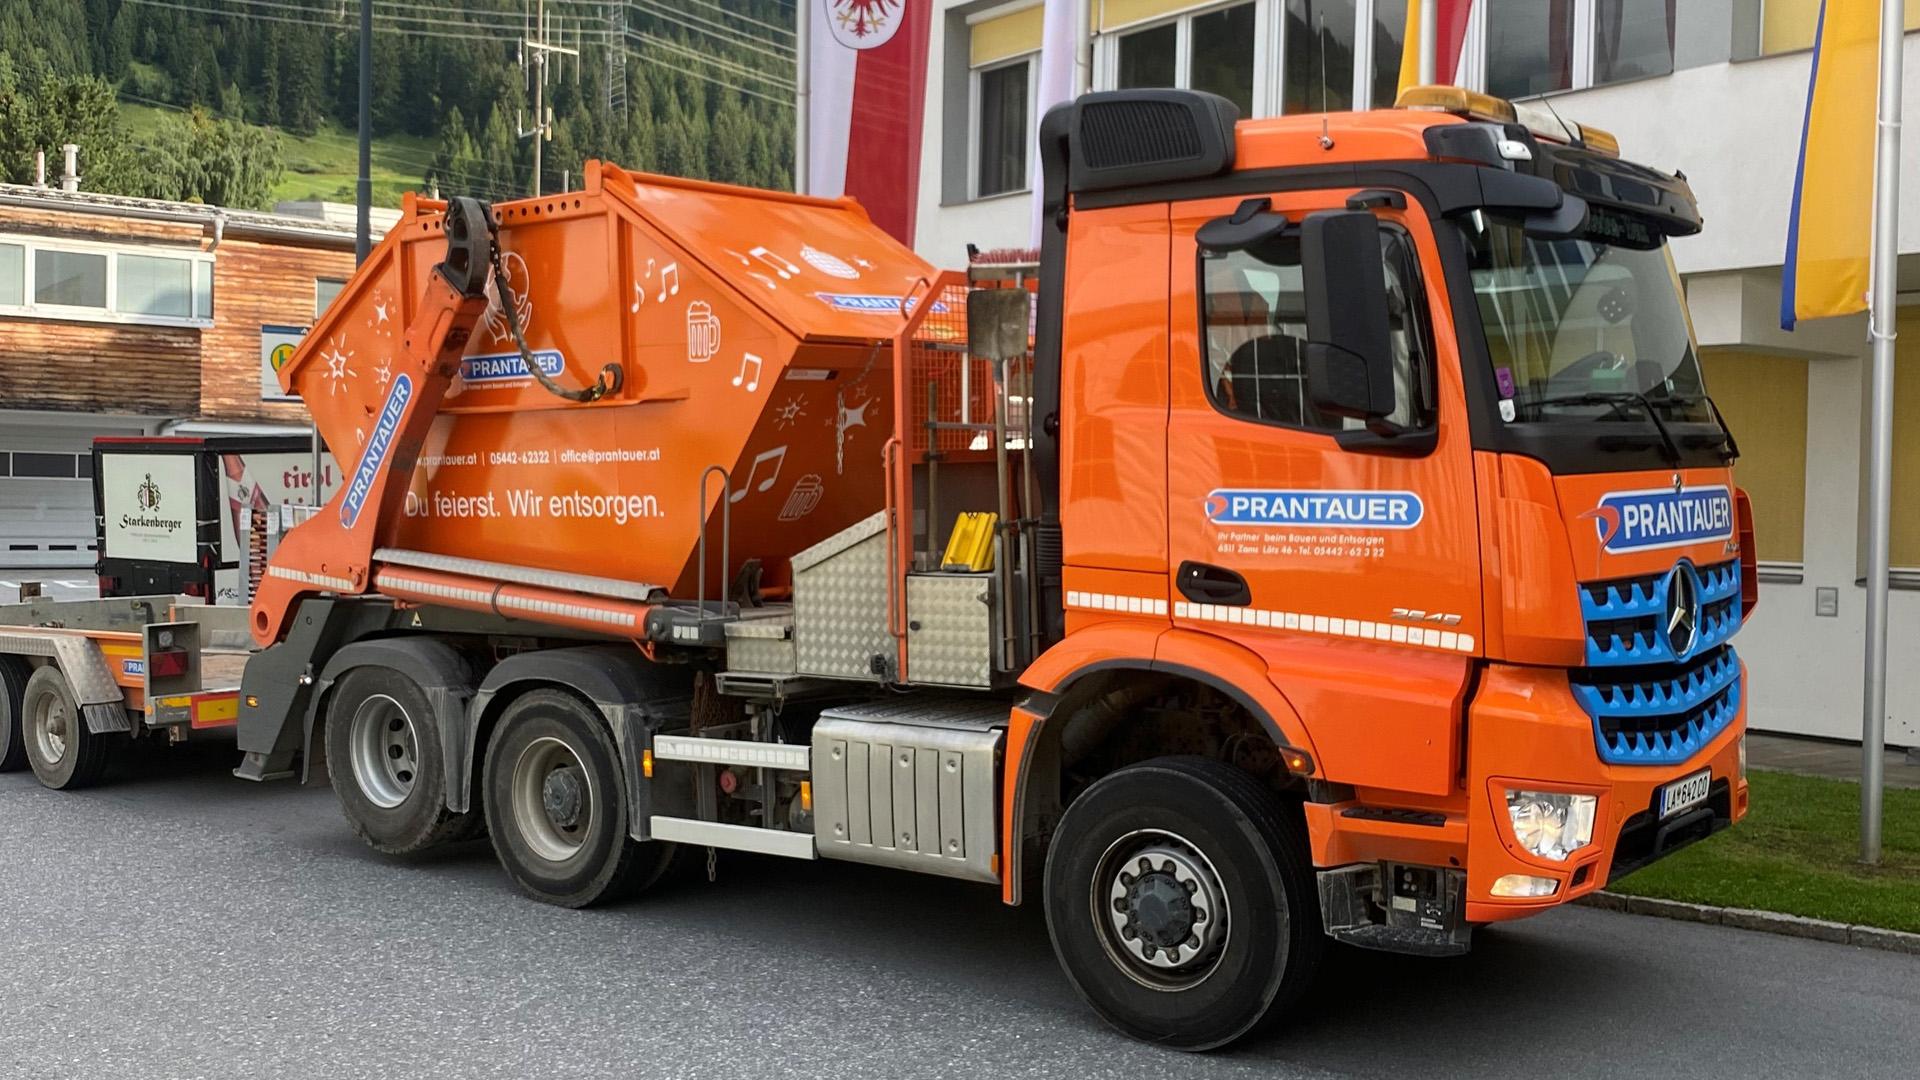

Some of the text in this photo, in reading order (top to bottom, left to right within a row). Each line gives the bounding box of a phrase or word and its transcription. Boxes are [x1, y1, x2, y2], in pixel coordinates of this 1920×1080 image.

[349, 383, 408, 510] PRANTAUER
[490, 452, 550, 465] 05442-62322
[561, 448, 660, 465] office@prantauer.at
[405, 489, 665, 525] Du feierst. Wir entsorgen.
[1232, 496, 1408, 521] PRANTAUER
[119, 514, 182, 532] Starkenberger
[1623, 497, 1730, 540] PRANTAUER
[1218, 532, 1384, 546] Ihr Partner beim Bauen und Entsorgen
[1313, 547, 1343, 556] 05442
[128, 661, 144, 674] PRA
